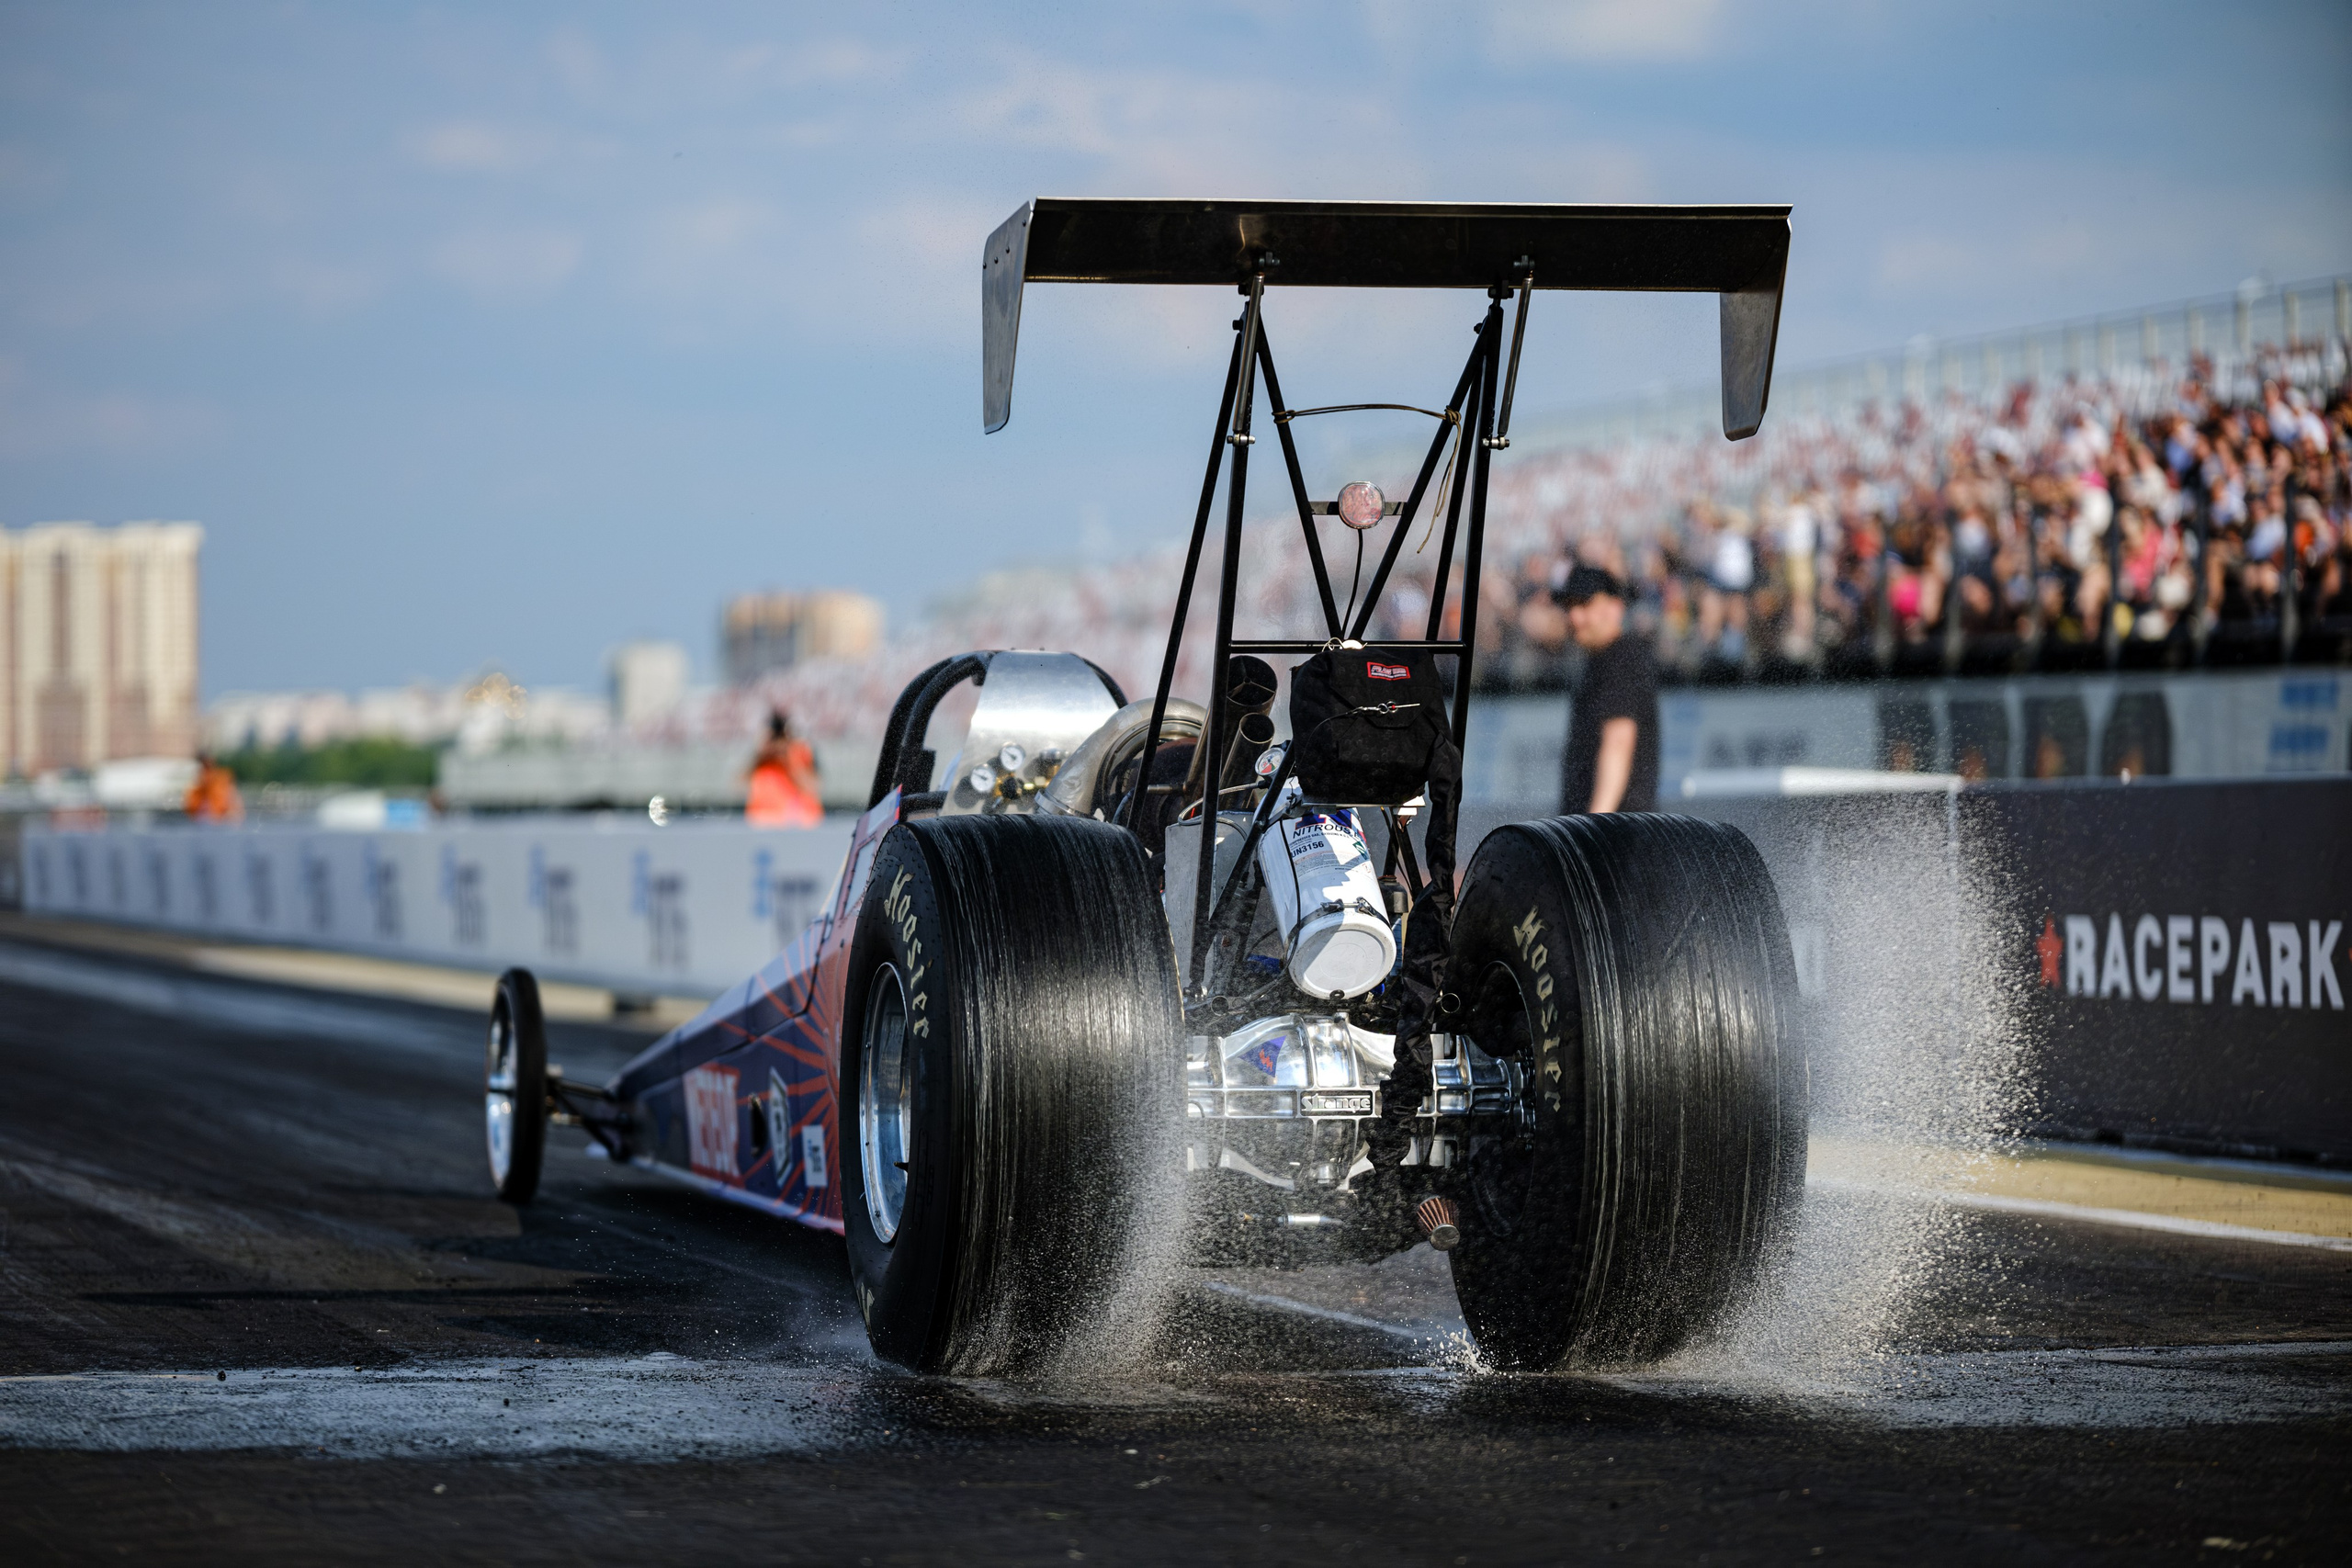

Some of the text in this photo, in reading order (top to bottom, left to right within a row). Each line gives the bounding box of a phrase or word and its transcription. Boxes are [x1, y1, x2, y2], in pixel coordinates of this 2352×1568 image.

[1293, 824, 1351, 839] NITROUS
[1291, 840, 1325, 857] UN3156
[2066, 911, 2345, 1010] RACEPARK
[1301, 1092, 1371, 1113] Strange
